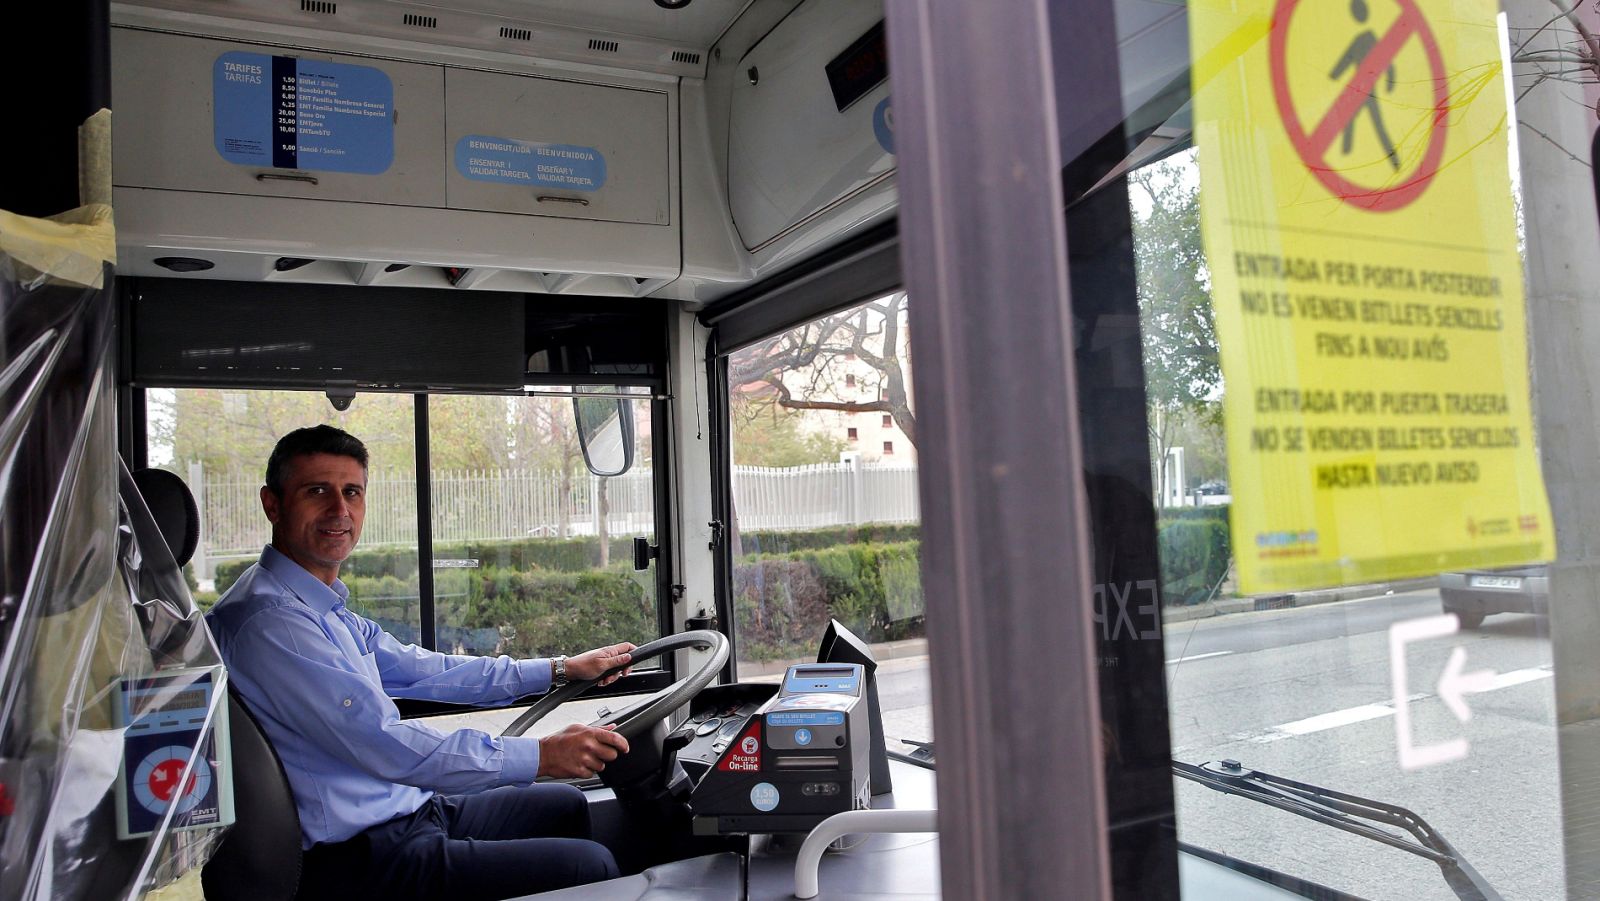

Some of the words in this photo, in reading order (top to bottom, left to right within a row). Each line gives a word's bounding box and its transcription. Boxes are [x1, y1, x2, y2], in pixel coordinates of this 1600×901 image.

[224, 62, 262, 75] TARIFES
[224, 72, 262, 85] TARIFAS
[363, 101, 384, 109] General
[363, 109, 386, 117] Especial
[469, 141, 531, 154] BENVINGUT/UDA
[537, 148, 594, 161] BIENVENIDO/A
[469, 158, 505, 168] ENSENYAR
[537, 163, 568, 175] ENSEÑAR
[568, 167, 574, 175] Y
[469, 167, 499, 176] VALIDAR
[537, 173, 566, 182] VALIDAR
[1234, 250, 1322, 284] ENTRADA
[1323, 261, 1360, 288] PER
[1362, 264, 1418, 293] PORTA
[1418, 270, 1502, 299] POSTERIOR
[1239, 289, 1268, 316] NO
[1271, 292, 1293, 318] ES
[1295, 295, 1357, 322] VENEN
[1360, 300, 1433, 327] BITLLETS
[1435, 304, 1504, 331] SENZILLS
[1315, 332, 1352, 358] FINS
[1358, 335, 1372, 358] A
[1374, 336, 1409, 361] NOU
[1411, 333, 1448, 362] AVÍS
[1255, 388, 1338, 415] ENTRADA
[1341, 391, 1377, 415] POR
[1378, 391, 1441, 416] PUERTA
[1444, 393, 1510, 416] TRASERA
[1252, 427, 1279, 452] NO
[1283, 427, 1304, 451] SE
[1307, 427, 1374, 451] VENDEN
[1376, 427, 1445, 451] BILLETES
[1447, 426, 1520, 449] SENCILLOS
[1317, 463, 1372, 490] HASTA
[1375, 462, 1433, 487] NUEVO
[1436, 460, 1480, 483] AVISO
[732, 754, 758, 763] Recarga
[729, 761, 758, 770] On-line
[755, 788, 774, 799] 1,50
[191, 808, 217, 816] EMT
